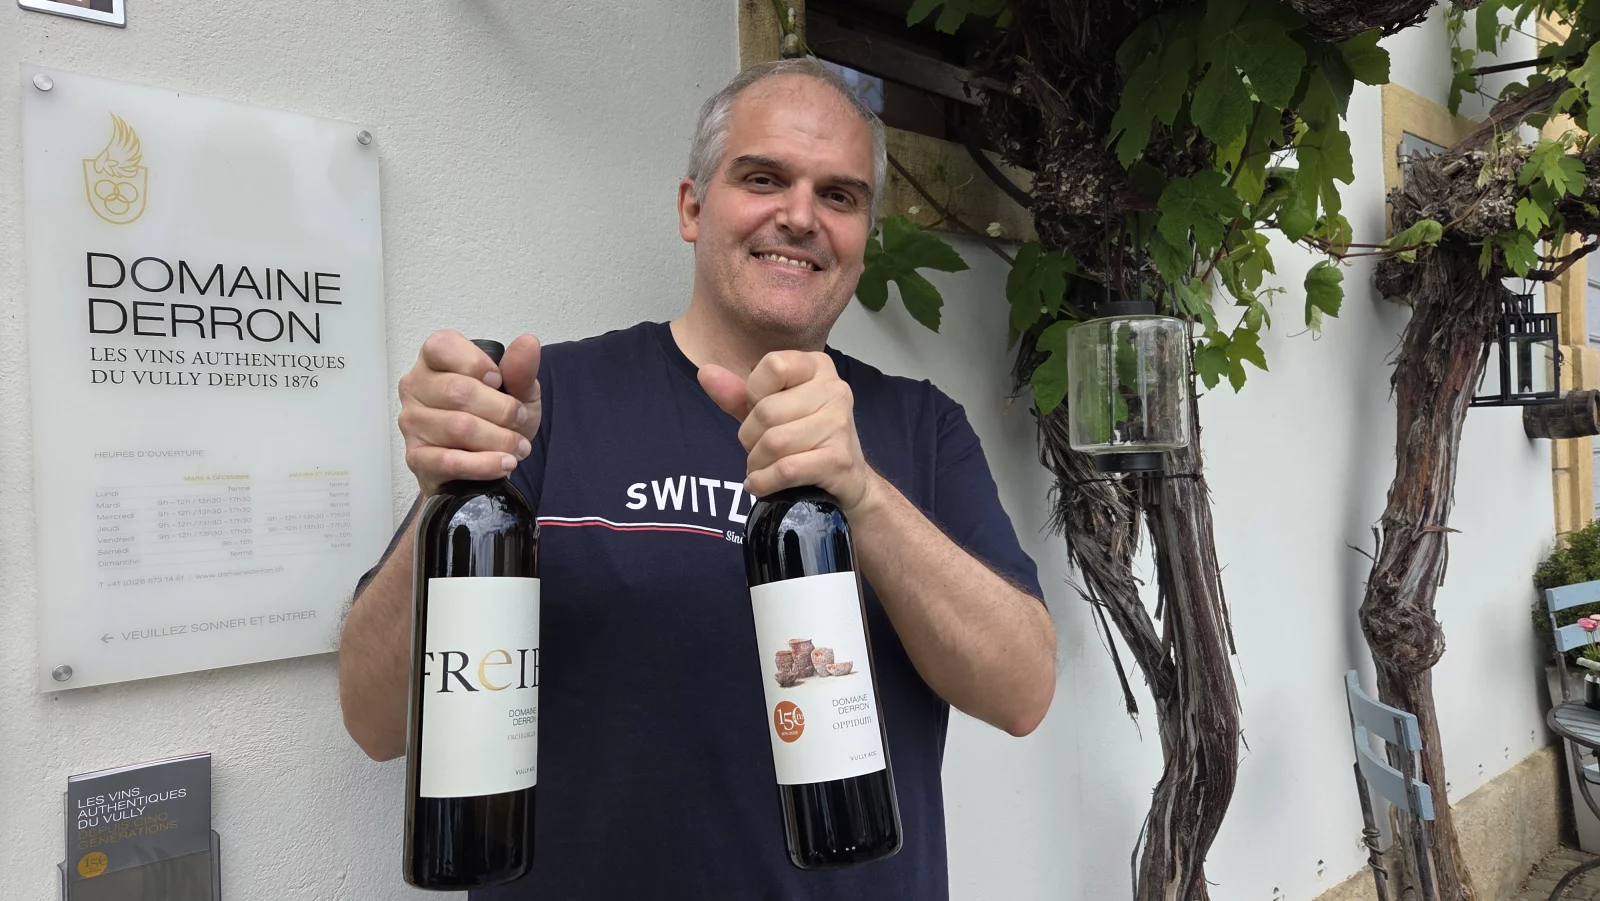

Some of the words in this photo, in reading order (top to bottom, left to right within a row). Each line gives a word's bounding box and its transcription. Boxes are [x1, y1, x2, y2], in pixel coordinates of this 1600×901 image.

[86, 251, 342, 305] DOMAINE
[88, 297, 321, 344] DERRON
[90, 347, 127, 363] LES
[133, 348, 185, 365] VINS
[191, 351, 345, 371] AUTHENTIQUES
[90, 369, 125, 385] DU
[131, 370, 202, 387] VULLY
[208, 372, 278, 388] DEPUIS
[283, 374, 319, 388] 1876
[94, 451, 135, 459] HEURES
[137, 449, 205, 458] D'OUVERTURE
[96, 536, 135, 544] Vendredi
[98, 559, 139, 568] Dimanche
[121, 625, 187, 641] VEUILLEZ
[190, 618, 246, 633] SONNER
[249, 616, 265, 626] ET
[268, 610, 316, 624] ENTRER
[832, 693, 868, 707] DOMAINE
[838, 702, 870, 715] DERRON
[508, 706, 536, 718] DOMAINE
[850, 753, 867, 761] VULLY
[867, 750, 877, 758] AOC
[77, 788, 187, 819] AUTHENTIQUES
[78, 795, 105, 809] LES
[108, 787, 140, 801] VINS
[78, 817, 99, 830] DU
[103, 806, 146, 823] VULLY
[78, 821, 130, 840] DEPUIS
[133, 812, 168, 827] CINQ
